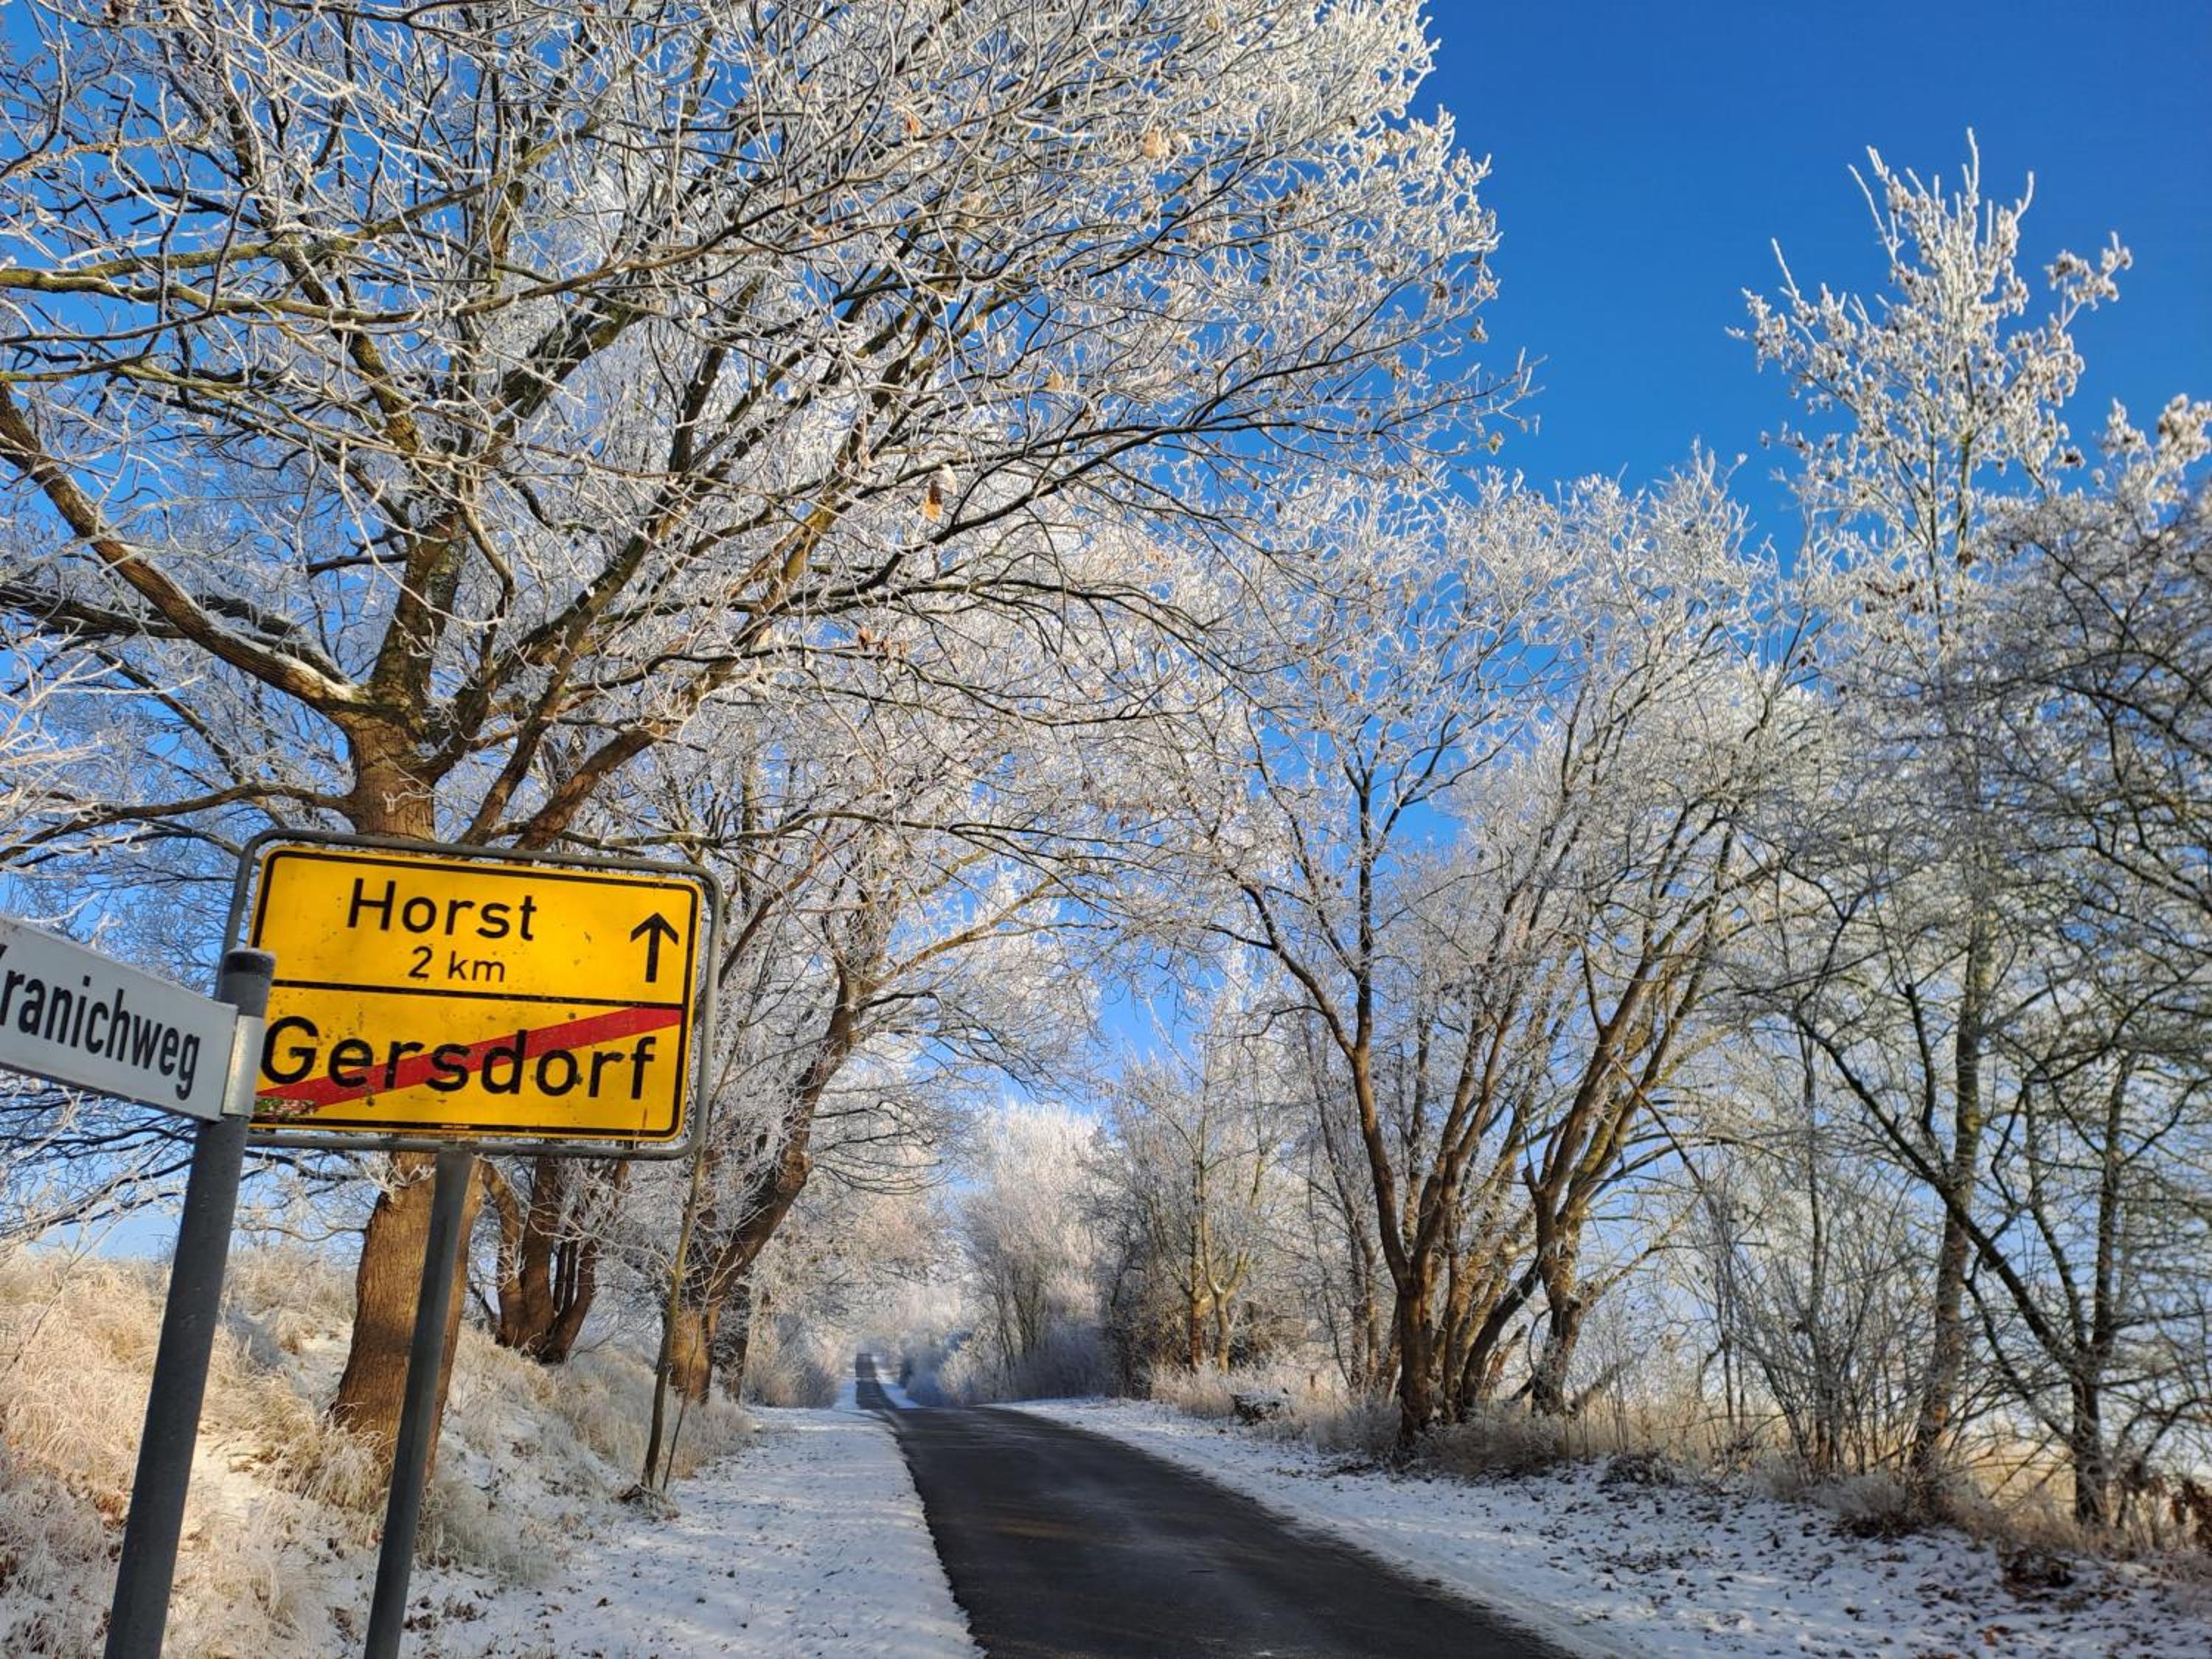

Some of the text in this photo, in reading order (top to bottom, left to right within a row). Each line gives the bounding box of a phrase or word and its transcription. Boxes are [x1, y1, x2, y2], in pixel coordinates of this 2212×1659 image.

[347, 877, 538, 942] Horst
[407, 946, 506, 982] 2 km
[0, 944, 201, 1101] ranichweg
[260, 1015, 657, 1100] Gersdorf
